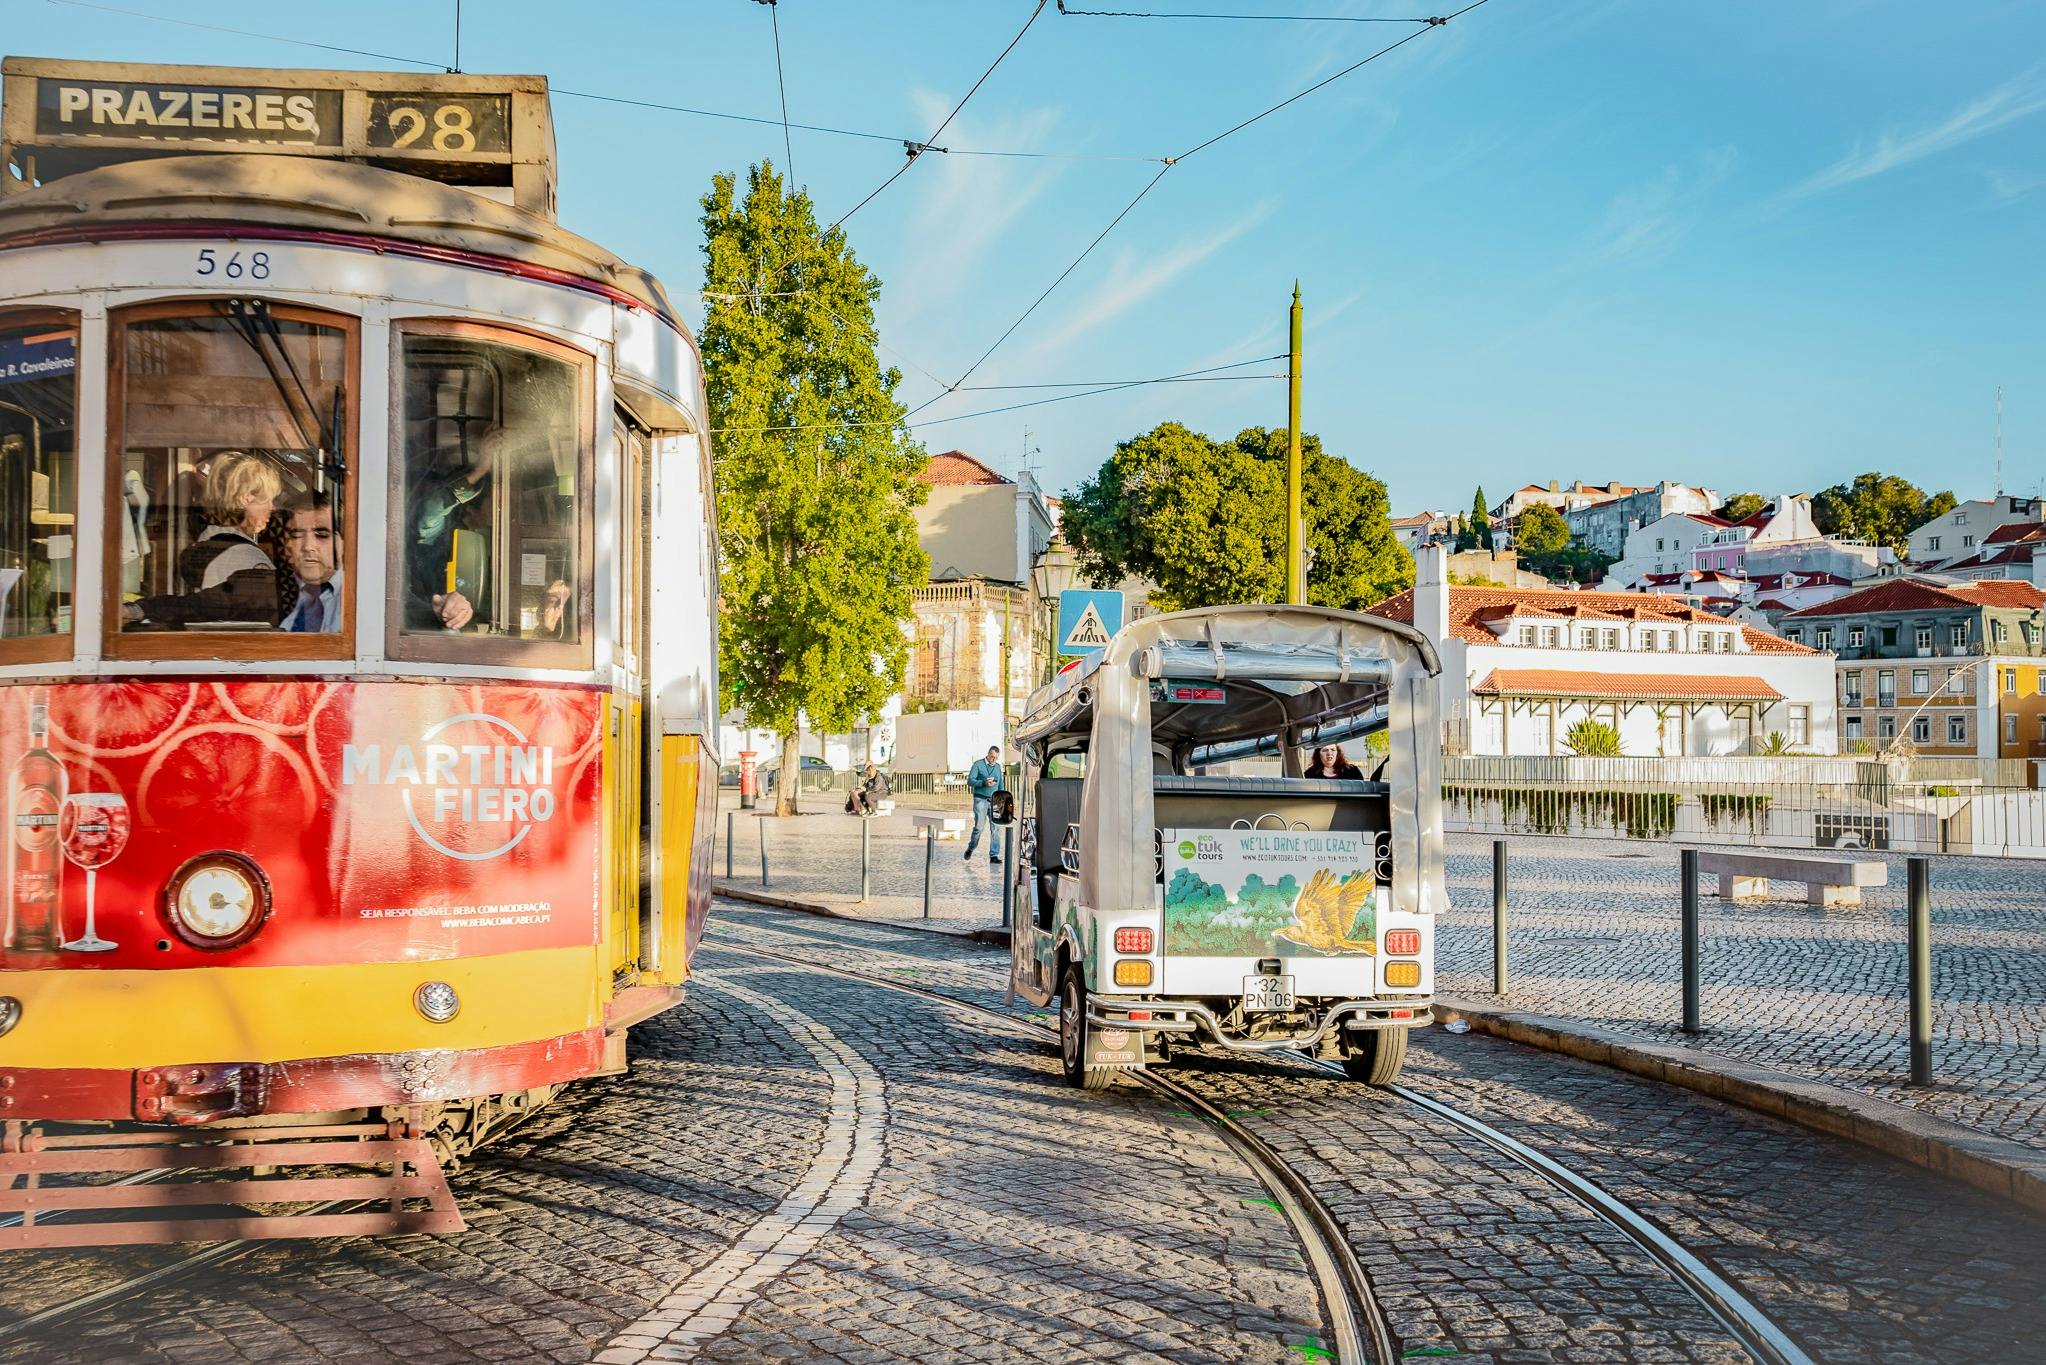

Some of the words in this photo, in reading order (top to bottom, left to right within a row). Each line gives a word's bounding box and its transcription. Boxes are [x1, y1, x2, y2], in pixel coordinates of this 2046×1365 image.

[59, 87, 316, 132] PRAZERES
[388, 104, 476, 153] 28
[196, 248, 270, 280] 568
[20, 356, 76, 374] Cavaleiros
[342, 743, 553, 785] MARTINI
[434, 788, 555, 823] FIERO
[1197, 834, 1214, 842] eco
[1240, 837, 1270, 851] WE'LL
[1273, 837, 1300, 852] DRIVE
[1303, 838, 1323, 852] YOU
[1326, 838, 1358, 853] CRAZY
[1197, 841, 1223, 853] tuk
[1197, 853, 1223, 861] tours
[360, 908, 384, 919] SEJA
[453, 905, 477, 916] BEBA
[477, 904, 498, 915] COM
[1261, 978, 1278, 993] 32
